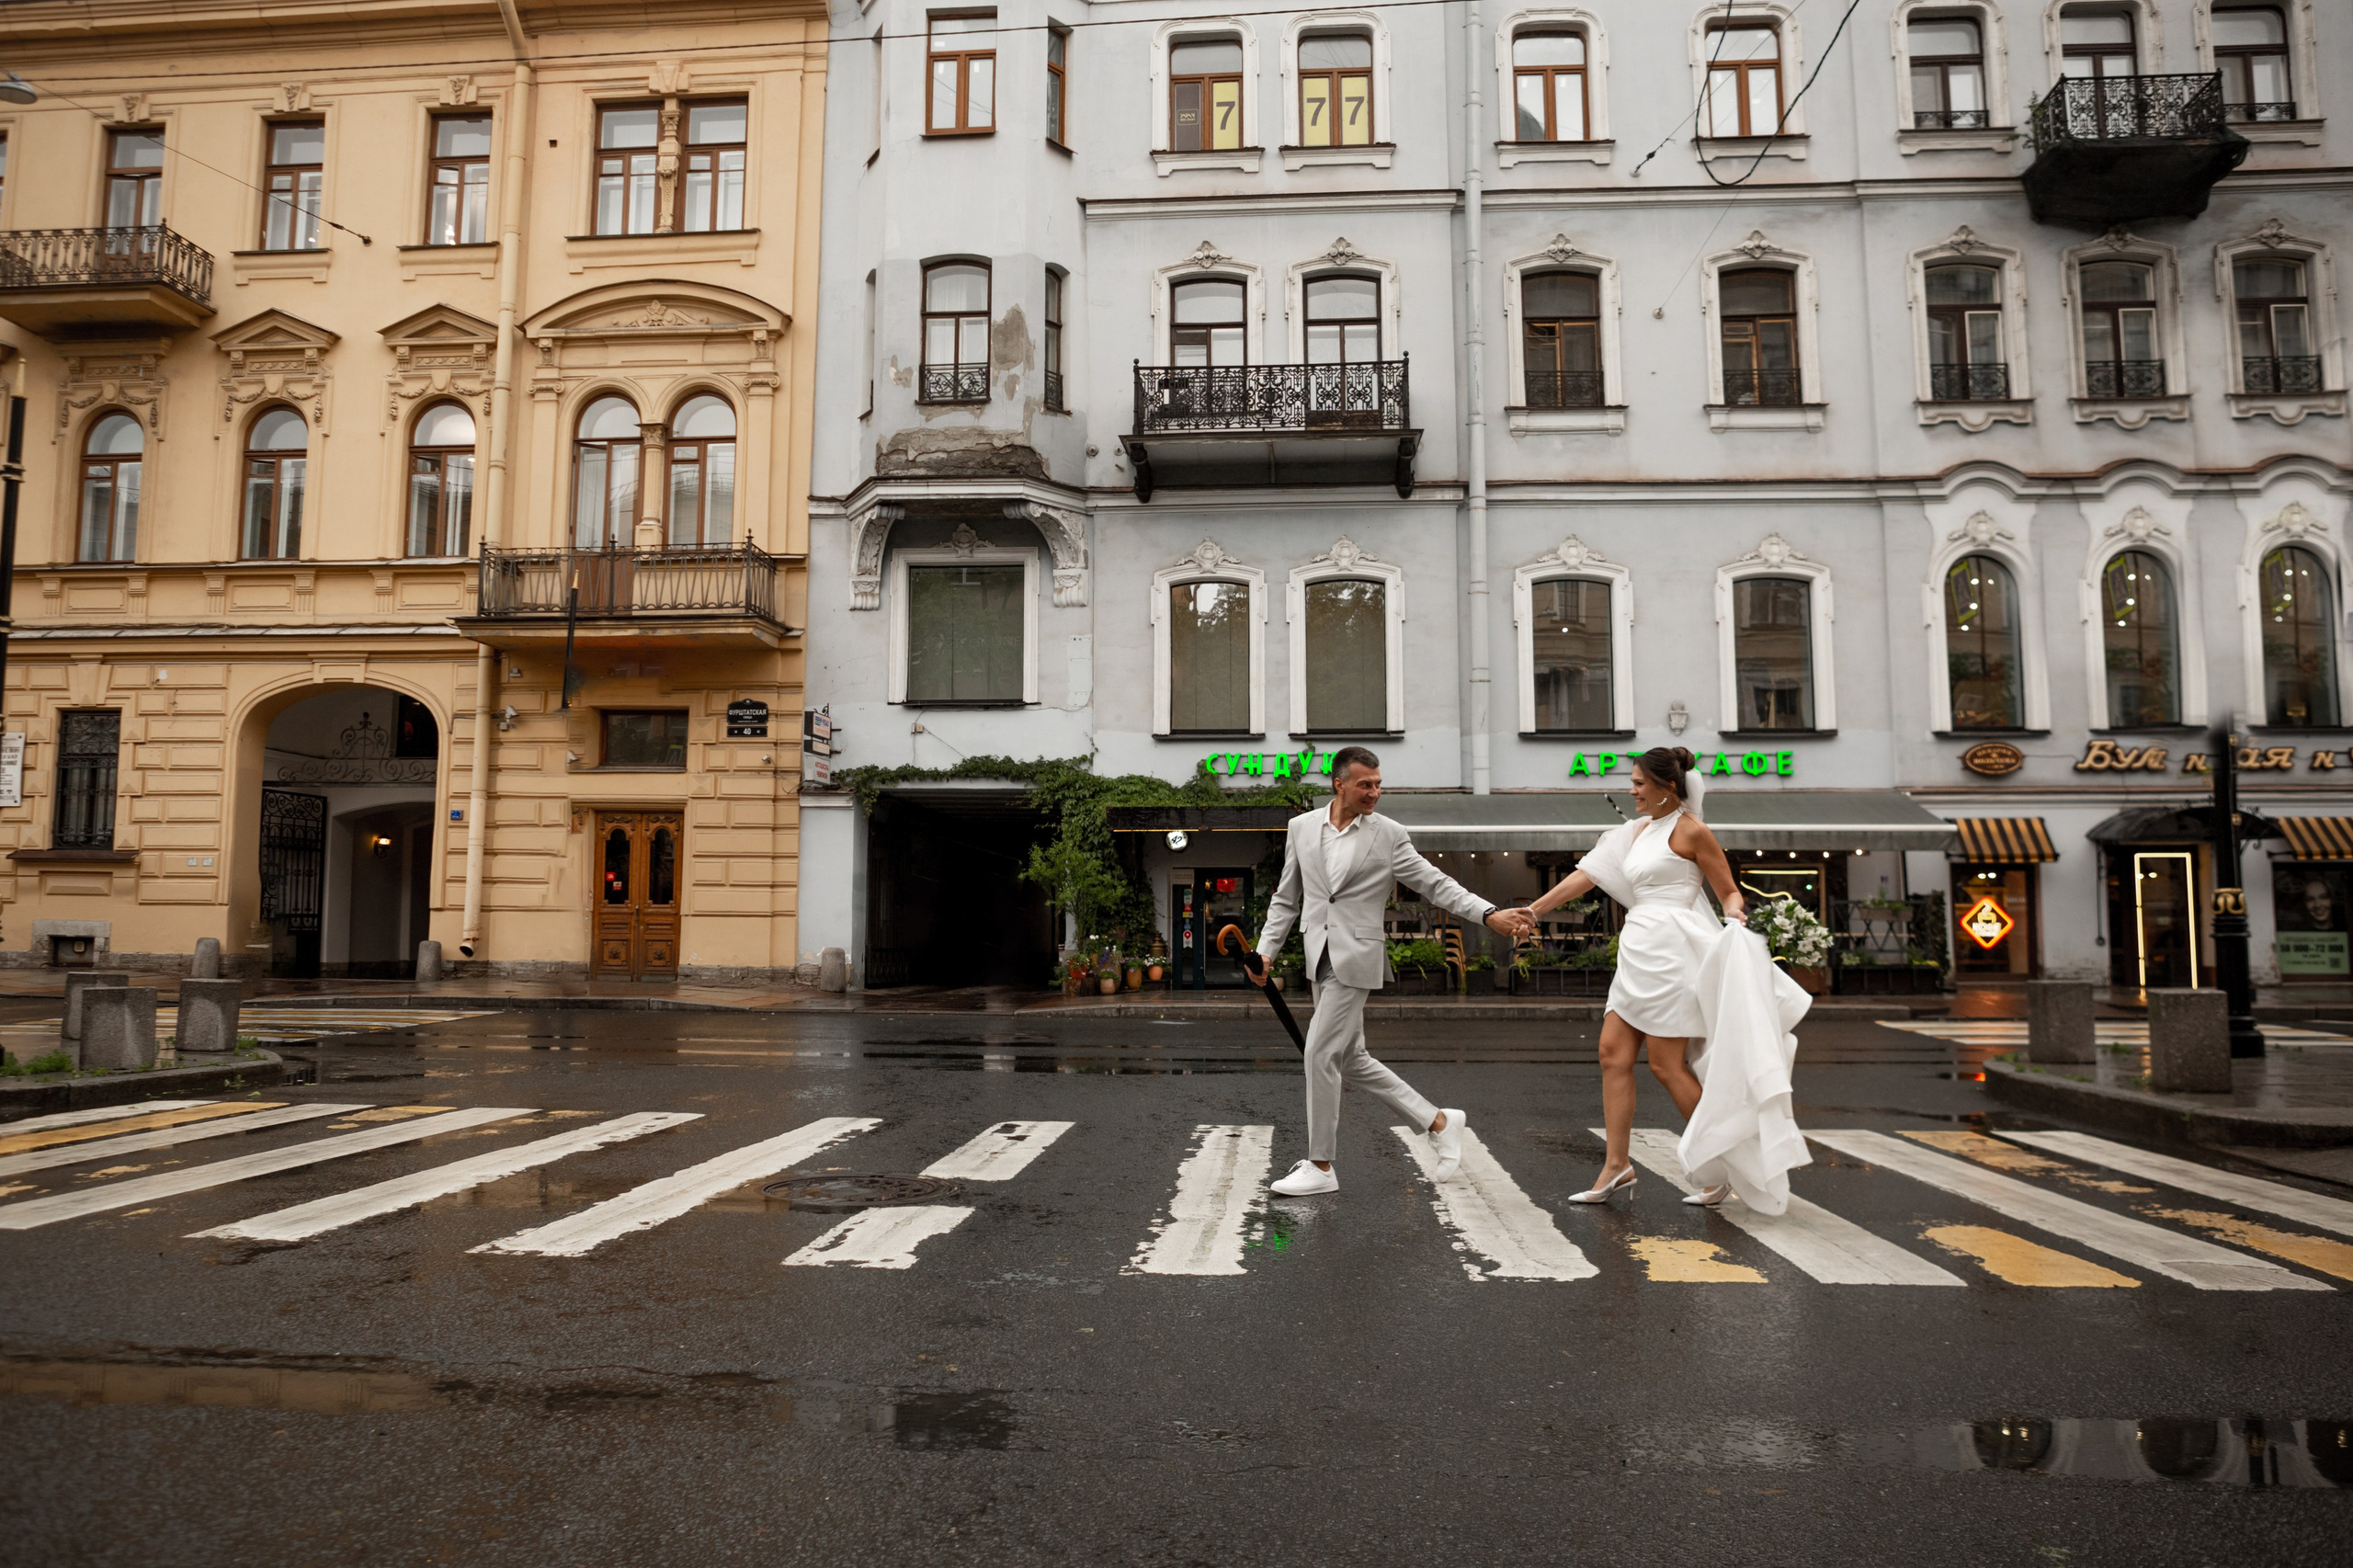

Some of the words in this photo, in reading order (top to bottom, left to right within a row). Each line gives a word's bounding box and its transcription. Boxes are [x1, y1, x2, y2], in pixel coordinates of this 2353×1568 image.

[1216, 101, 1235, 131] 7
[1306, 97, 1326, 126] 7
[1345, 97, 1365, 125] 7
[743, 727, 752, 735] 40
[1205, 751, 1337, 778] СУНДУК
[1170, 835, 1184, 845] 42
